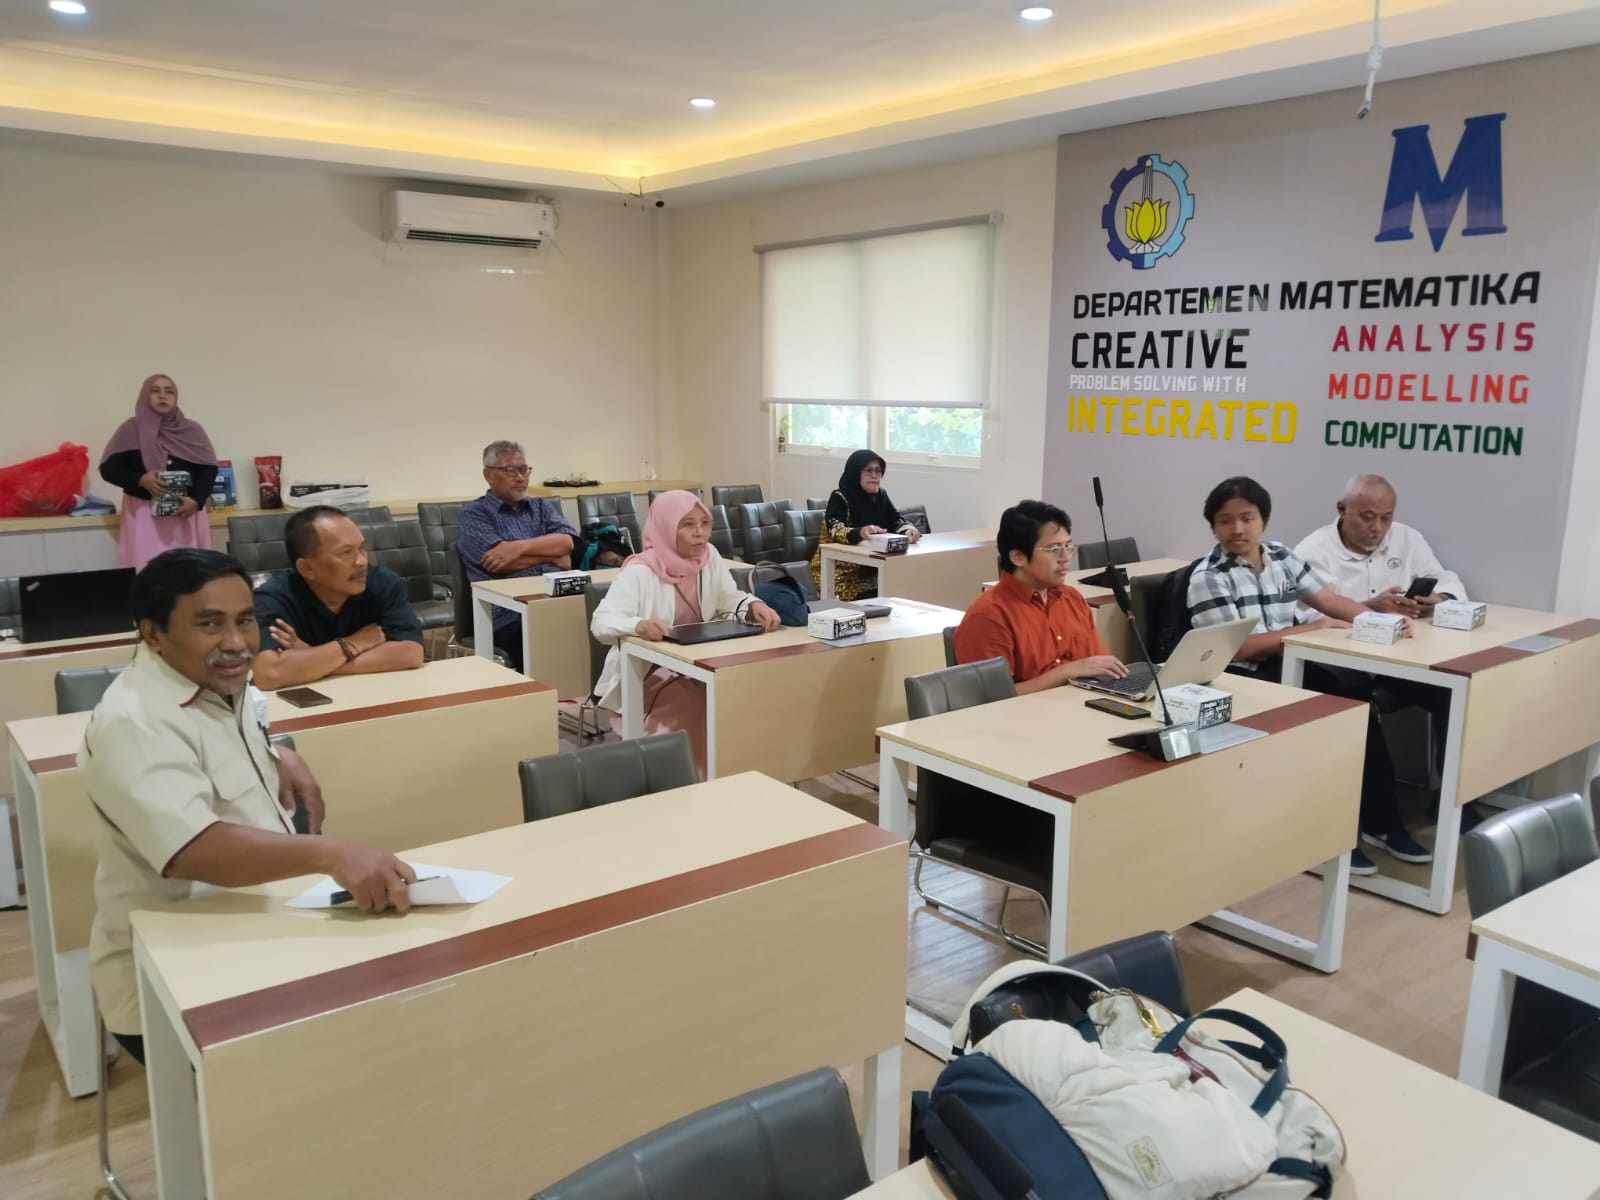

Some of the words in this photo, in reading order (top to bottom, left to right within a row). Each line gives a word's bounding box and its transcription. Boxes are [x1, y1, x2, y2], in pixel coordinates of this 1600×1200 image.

[1375, 112, 1508, 253] M
[1073, 283, 1270, 319] DEPARTEMEN
[1279, 270, 1541, 311] MATEMATIKA
[1071, 328, 1250, 369] CREATIVE
[1332, 322, 1536, 353] ANALYSIS
[1069, 374, 1130, 391] PROBLEM
[1134, 375, 1197, 392] SOLVING
[1202, 376, 1247, 393] WITH
[1327, 373, 1529, 404] MODELLING
[1067, 396, 1298, 444] INTEGRATED
[1324, 420, 1524, 456] COMPUTATION
